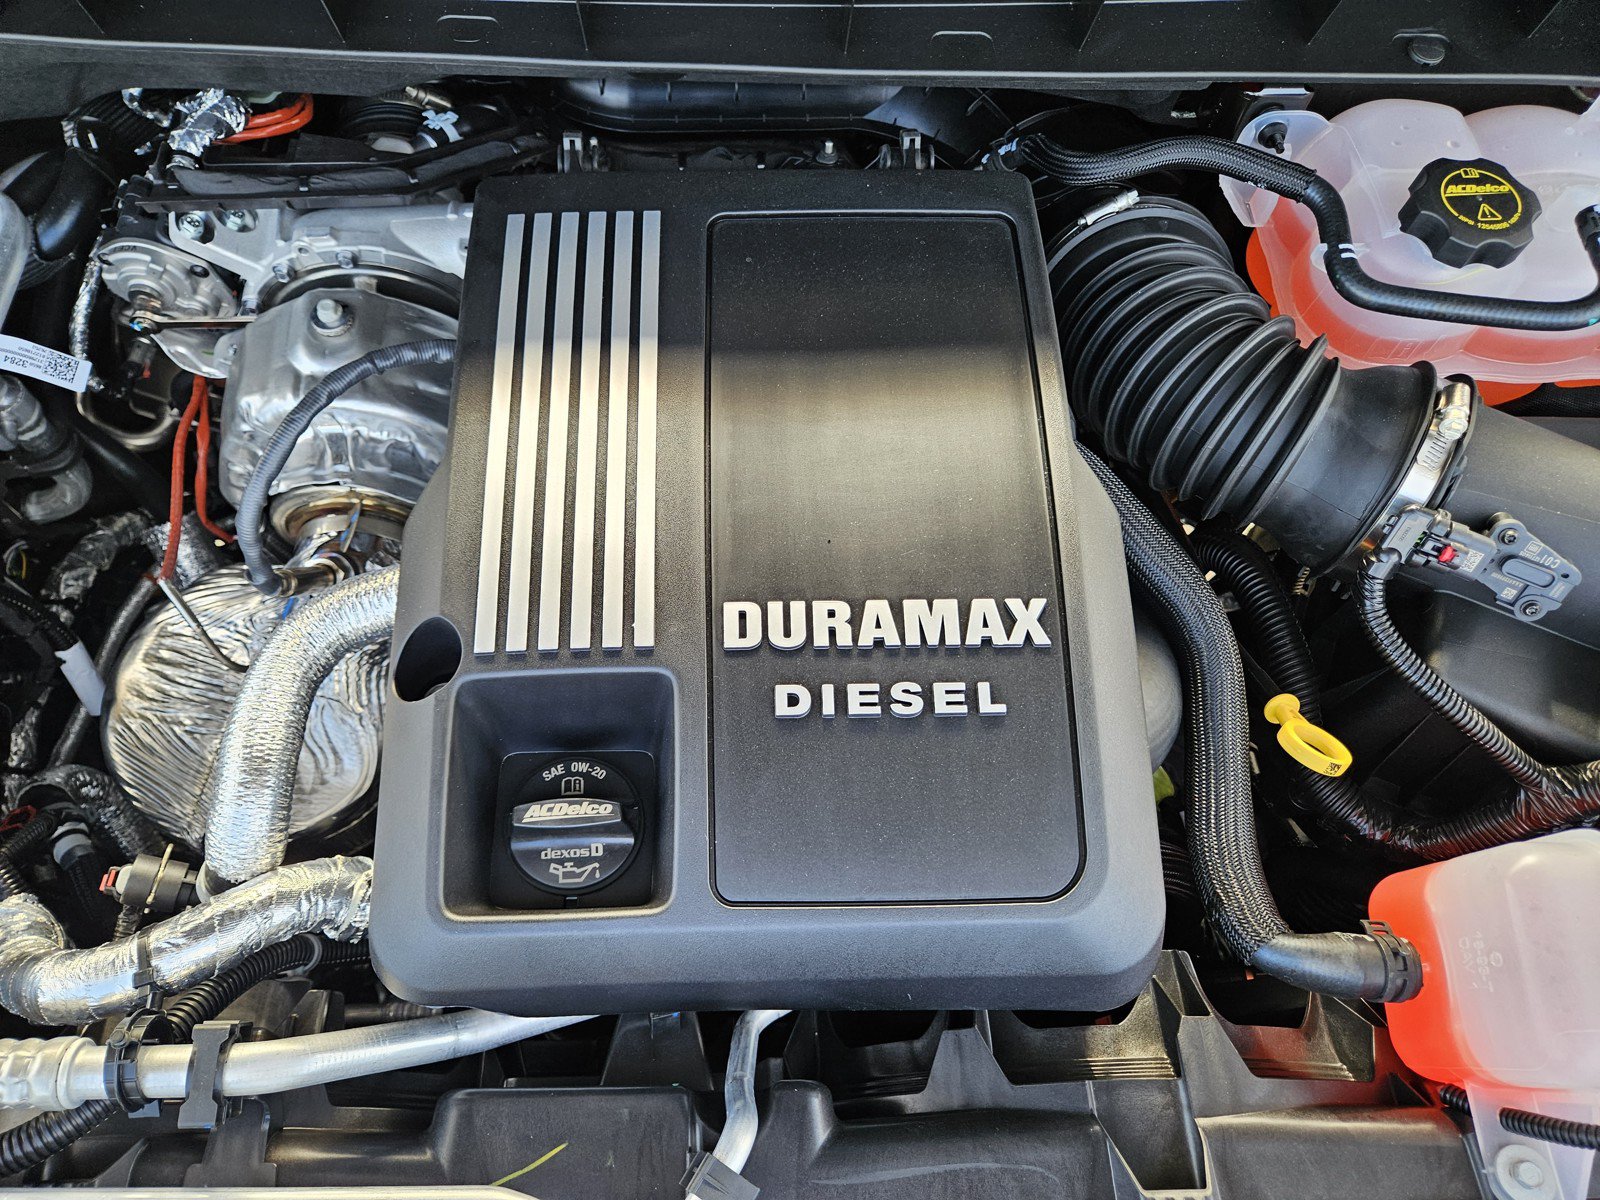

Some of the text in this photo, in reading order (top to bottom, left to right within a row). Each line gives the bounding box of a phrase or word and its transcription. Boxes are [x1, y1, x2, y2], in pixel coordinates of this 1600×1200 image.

[1446, 184, 1510, 194] ACDelco
[4, 355, 29, 368] 3284
[1540, 554, 1561, 569] C01
[723, 598, 1052, 650] DURAMAX
[774, 681, 1008, 719] DIESEL
[542, 761, 607, 782] SAE 0W-20
[522, 801, 615, 821] ACDelco
